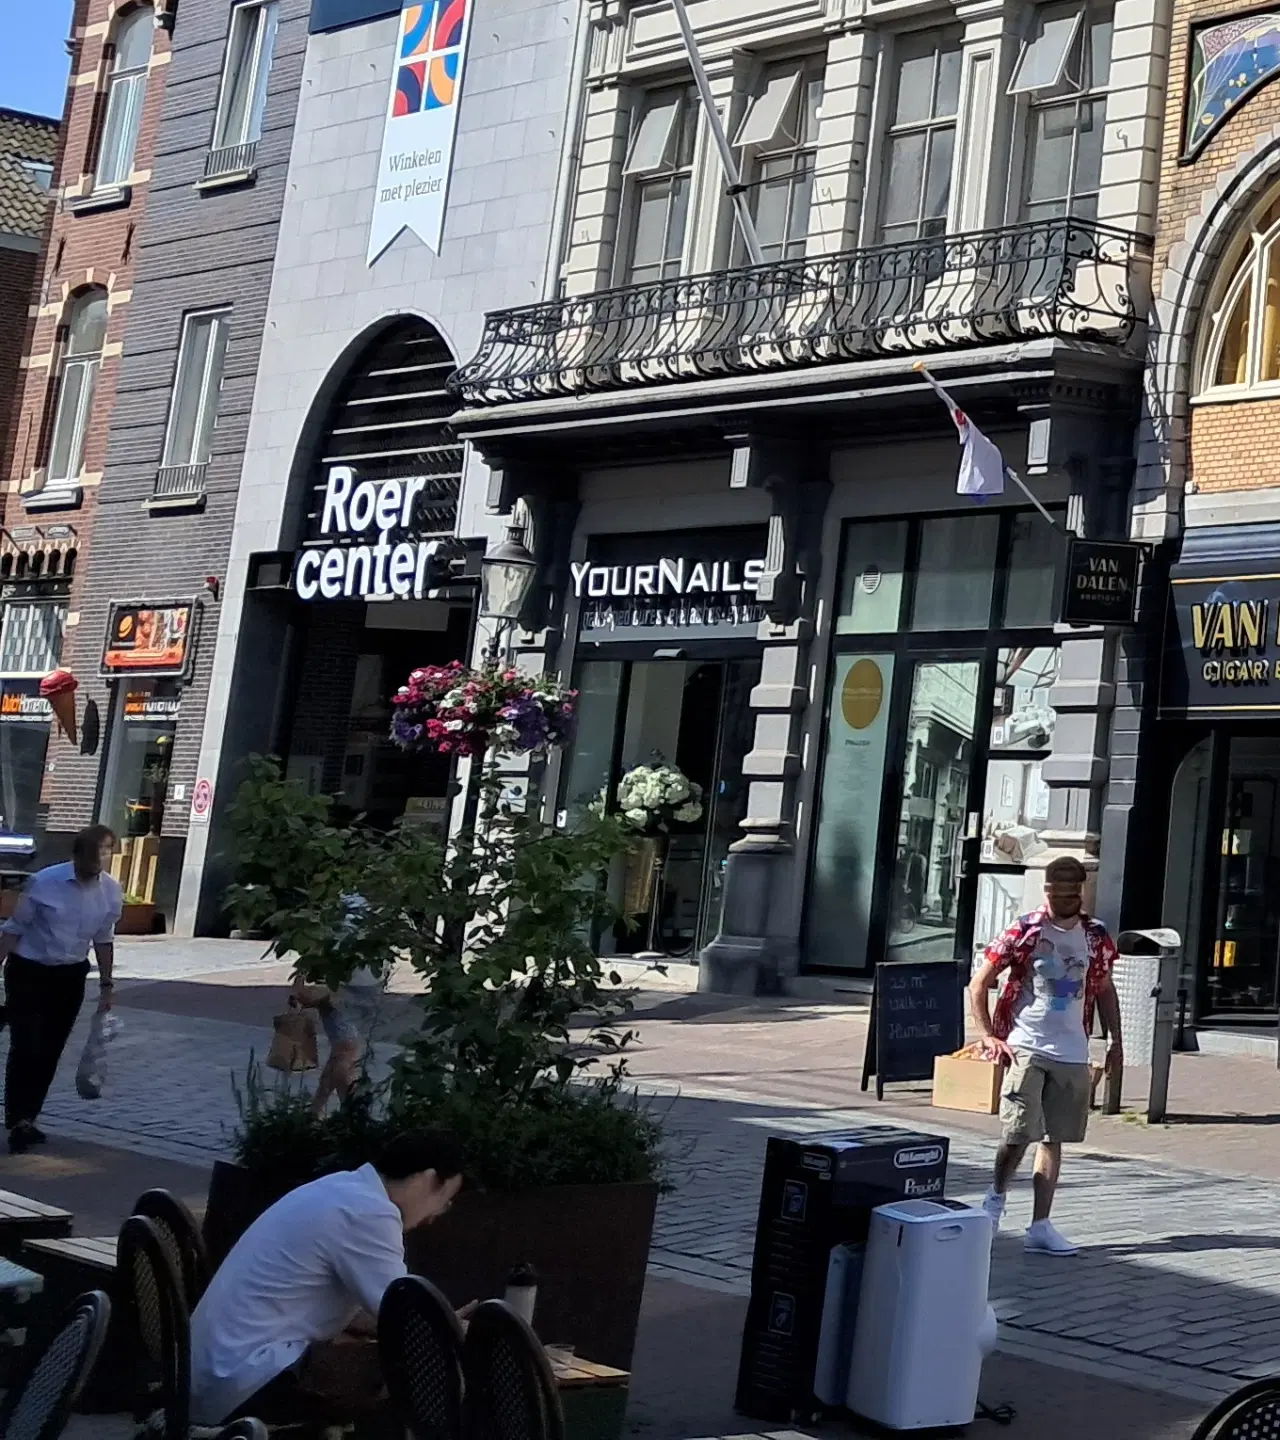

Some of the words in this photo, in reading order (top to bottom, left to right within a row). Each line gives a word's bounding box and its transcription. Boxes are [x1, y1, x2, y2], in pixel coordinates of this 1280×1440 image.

[388, 147, 442, 172] Winkelen
[379, 184, 402, 203] met
[404, 176, 443, 202] plezier
[320, 466, 426, 534] Roer
[296, 529, 440, 600] center
[1089, 557, 1119, 573] VAN
[1076, 573, 1128, 591] DALEN
[1191, 599, 1266, 649] VAN
[1202, 660, 1265, 681] CIGAR
